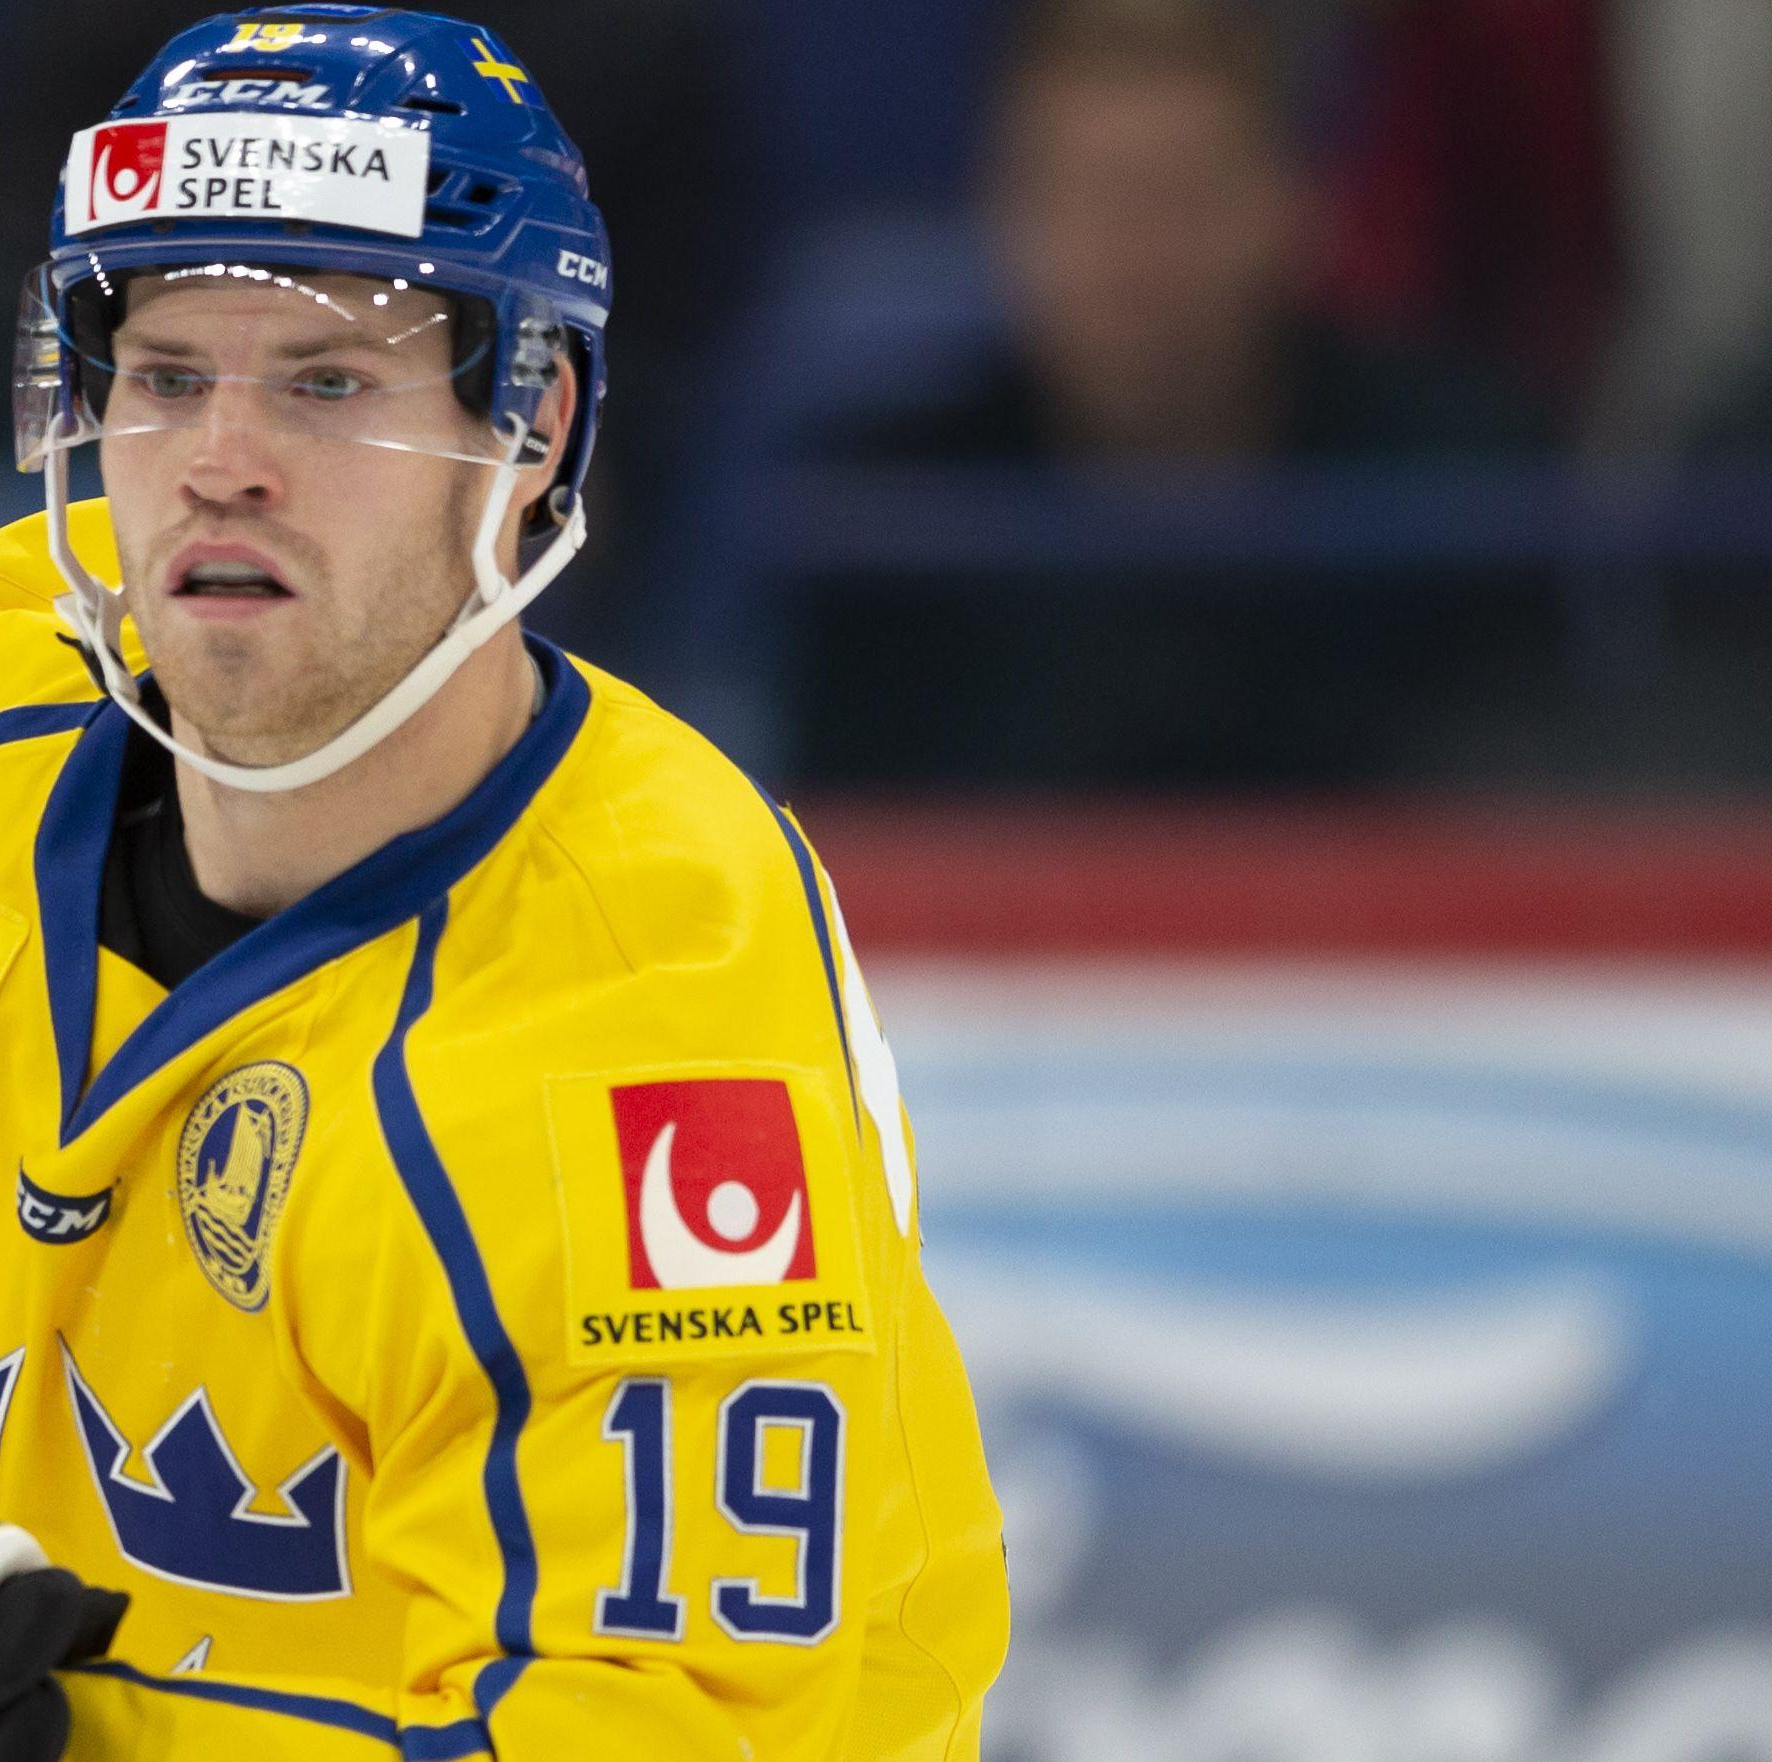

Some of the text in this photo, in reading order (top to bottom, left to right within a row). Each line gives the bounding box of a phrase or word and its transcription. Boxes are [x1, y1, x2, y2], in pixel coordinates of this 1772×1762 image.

[229, 23, 304, 52] 19
[175, 79, 330, 109] CCM
[181, 138, 390, 182] SVENSKA
[176, 177, 281, 209] SPEL
[557, 250, 608, 290] CCM
[582, 1301, 863, 1346] SVENSKA SPEL
[593, 1376, 846, 1646] 19
